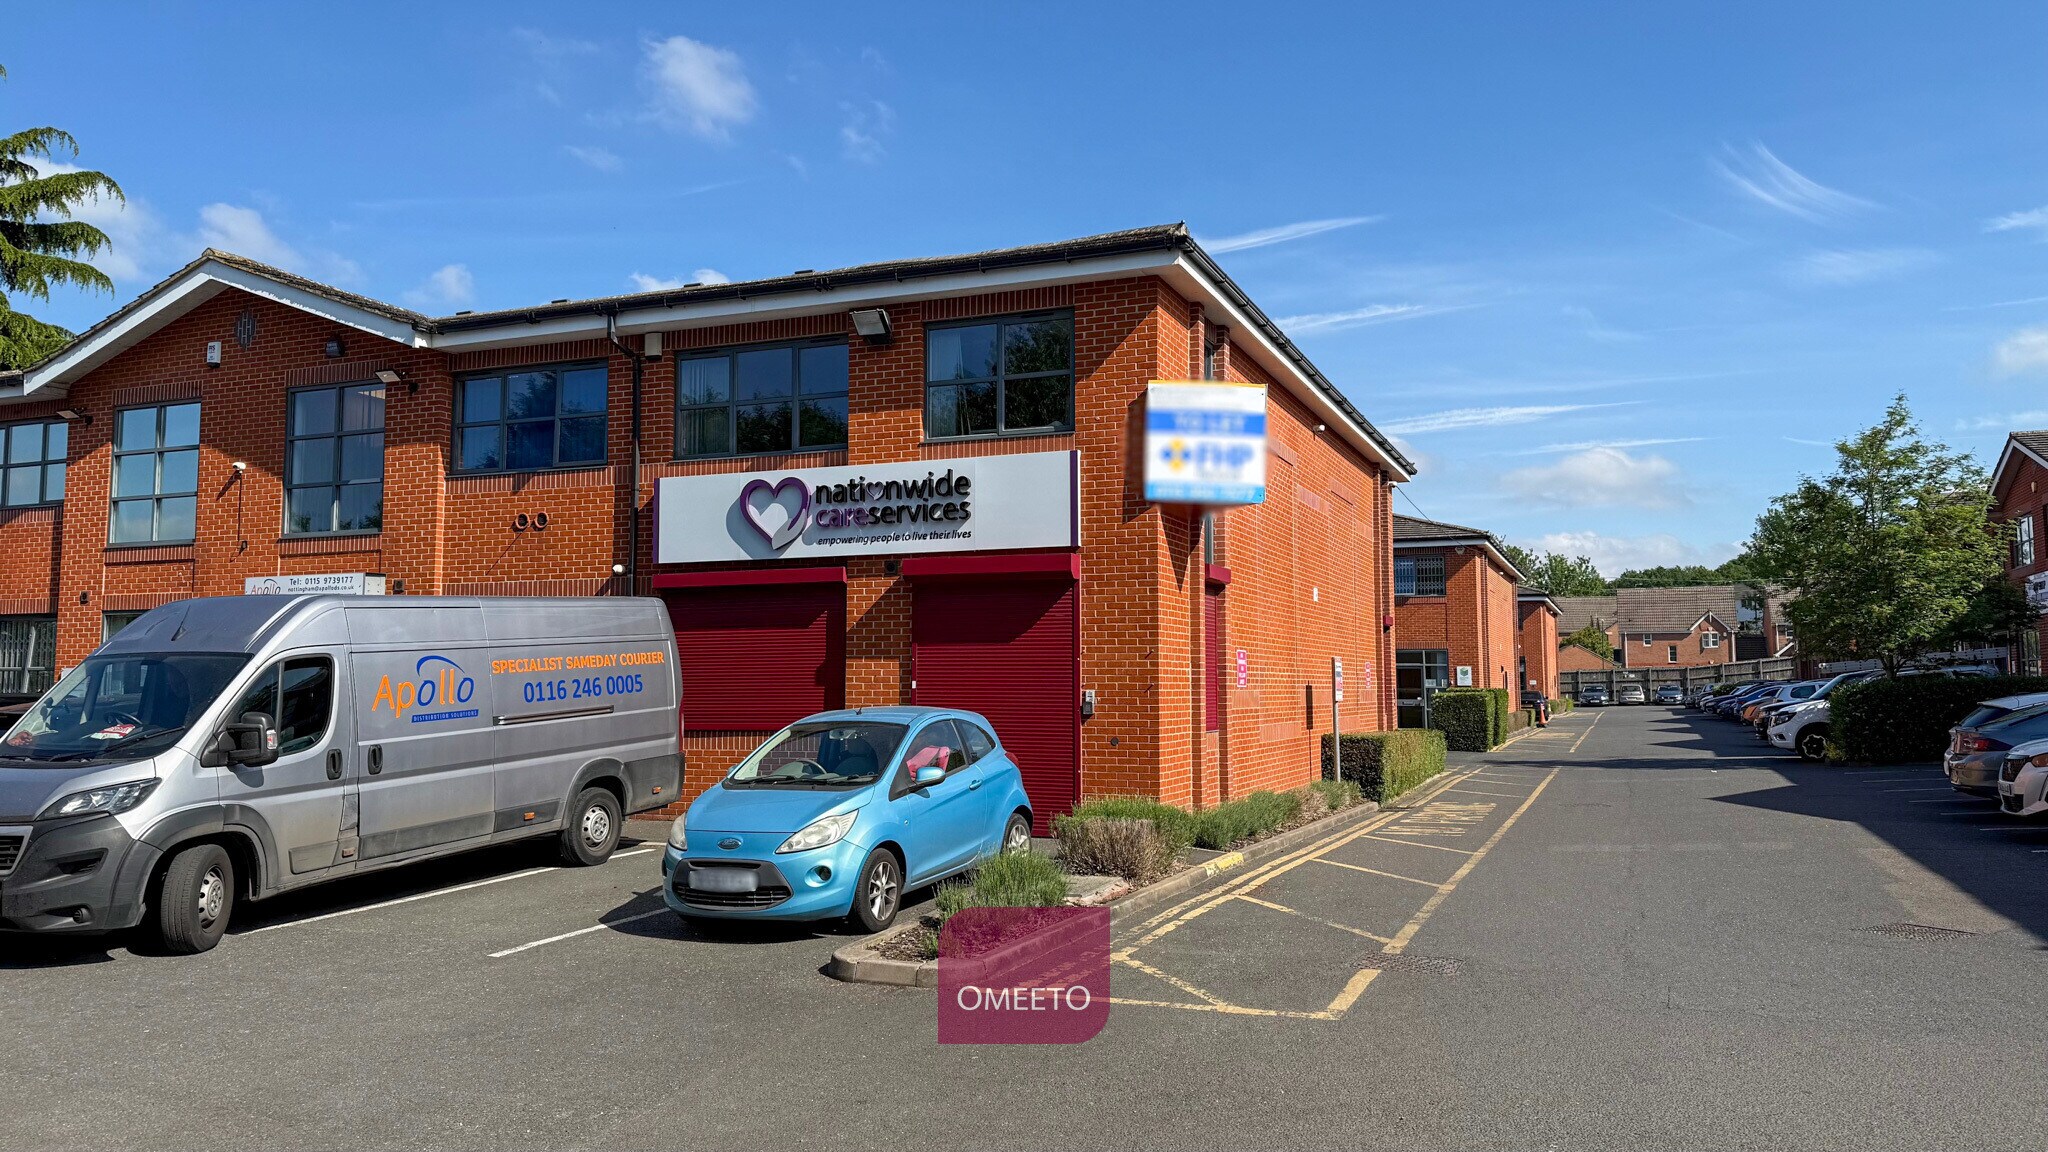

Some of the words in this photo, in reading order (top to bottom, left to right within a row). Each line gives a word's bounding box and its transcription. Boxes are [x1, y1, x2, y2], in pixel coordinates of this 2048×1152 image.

[815, 469, 971, 504] nationwide
[817, 535, 869, 546] empowering
[870, 533, 900, 544] people
[901, 532, 911, 541] to
[912, 530, 928, 541] live
[929, 529, 950, 540] their
[951, 529, 972, 540] lives
[305, 577, 320, 585] 0115
[323, 576, 354, 584] 9739177
[491, 657, 563, 674] SPECIALIST
[565, 654, 617, 670] SAMEDAY
[619, 651, 665, 666] COURIER
[371, 668, 475, 718] Apollo
[523, 680, 567, 703] 0116
[571, 677, 602, 698] 246
[606, 674, 644, 695] 0005
[413, 713, 449, 722] DISTRIBUTION
[450, 709, 478, 717] SOLUTIONS
